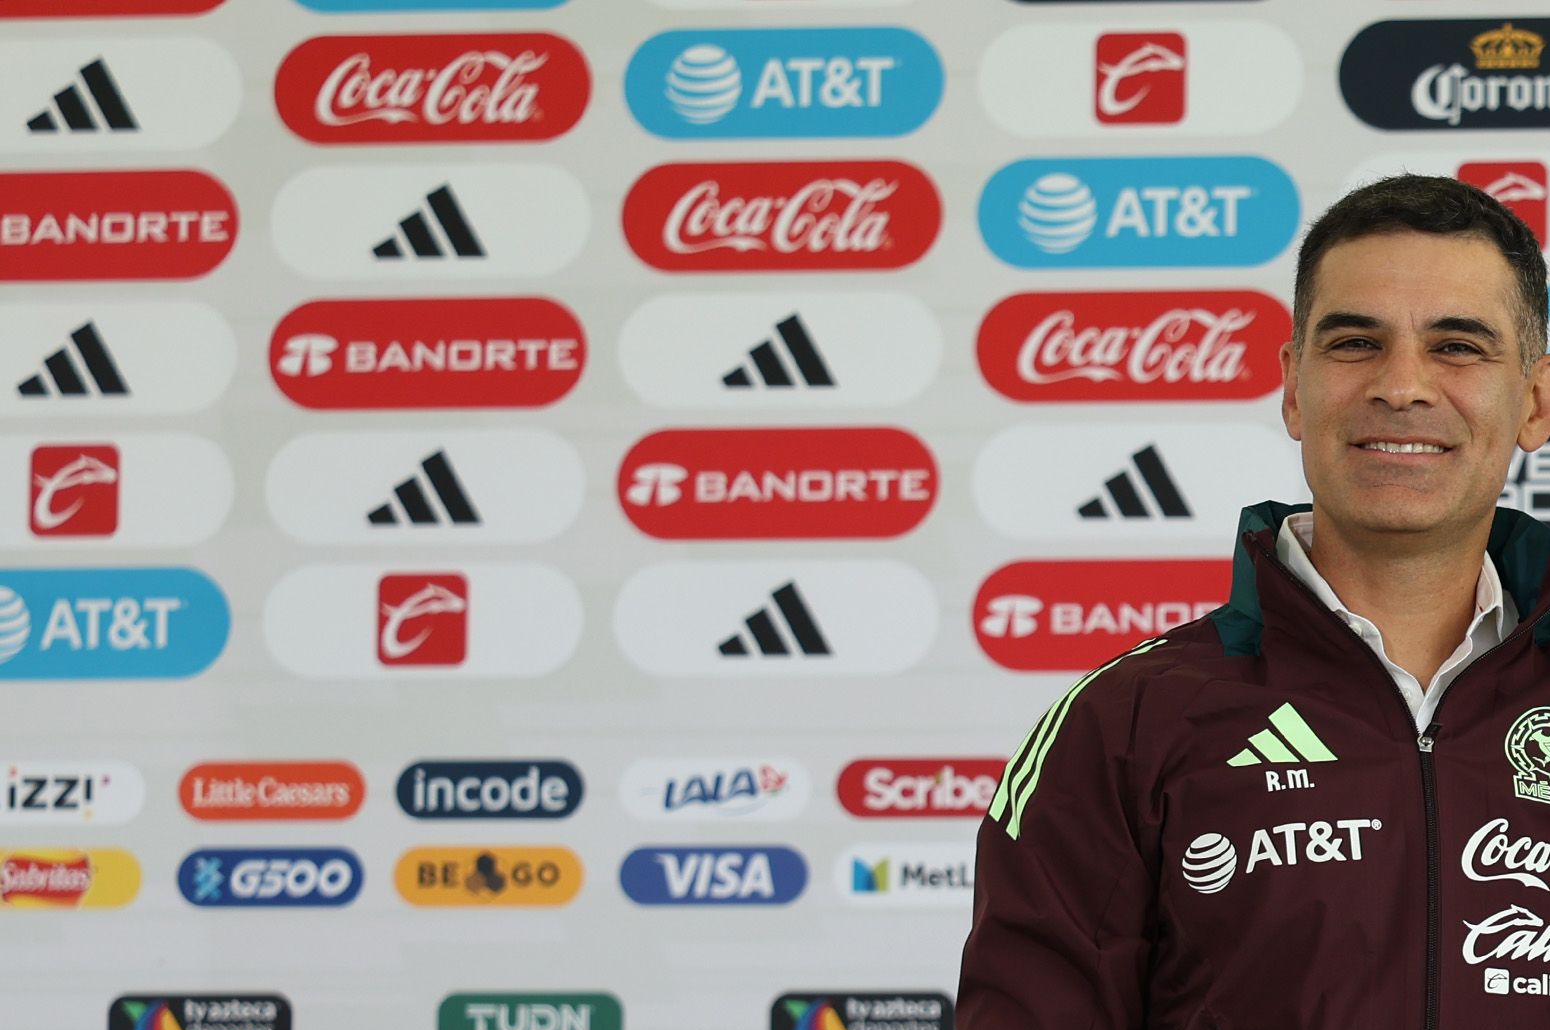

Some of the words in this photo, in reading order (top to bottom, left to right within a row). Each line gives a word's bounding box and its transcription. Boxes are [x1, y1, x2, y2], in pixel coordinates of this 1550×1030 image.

[315, 50, 549, 125] Coca-Cola
[751, 57, 894, 108] AT&T
[1, 211, 229, 245] BANORTE
[664, 179, 898, 253] Coca-Cola
[1107, 186, 1250, 238] AT&T
[346, 339, 578, 372] BANORTE
[1017, 307, 1256, 383] Coca-Cola
[697, 469, 929, 502] BANORTE
[41, 598, 177, 648] AT&T
[1050, 602, 1222, 636] BANO
[193, 776, 256, 808] Little
[257, 776, 350, 807] Caesars
[413, 765, 569, 812] incode
[664, 769, 757, 812] LALA
[864, 765, 997, 811] Scribe
[1266, 770, 1315, 792] R.M.
[1246, 819, 1370, 874] AT&T
[0, 861, 89, 894] Sabritas
[230, 858, 353, 898] G500
[655, 853, 775, 898] VISA
[902, 862, 974, 887] MetL
[208, 999, 277, 1021] azteca
[870, 998, 941, 1020] azteca
